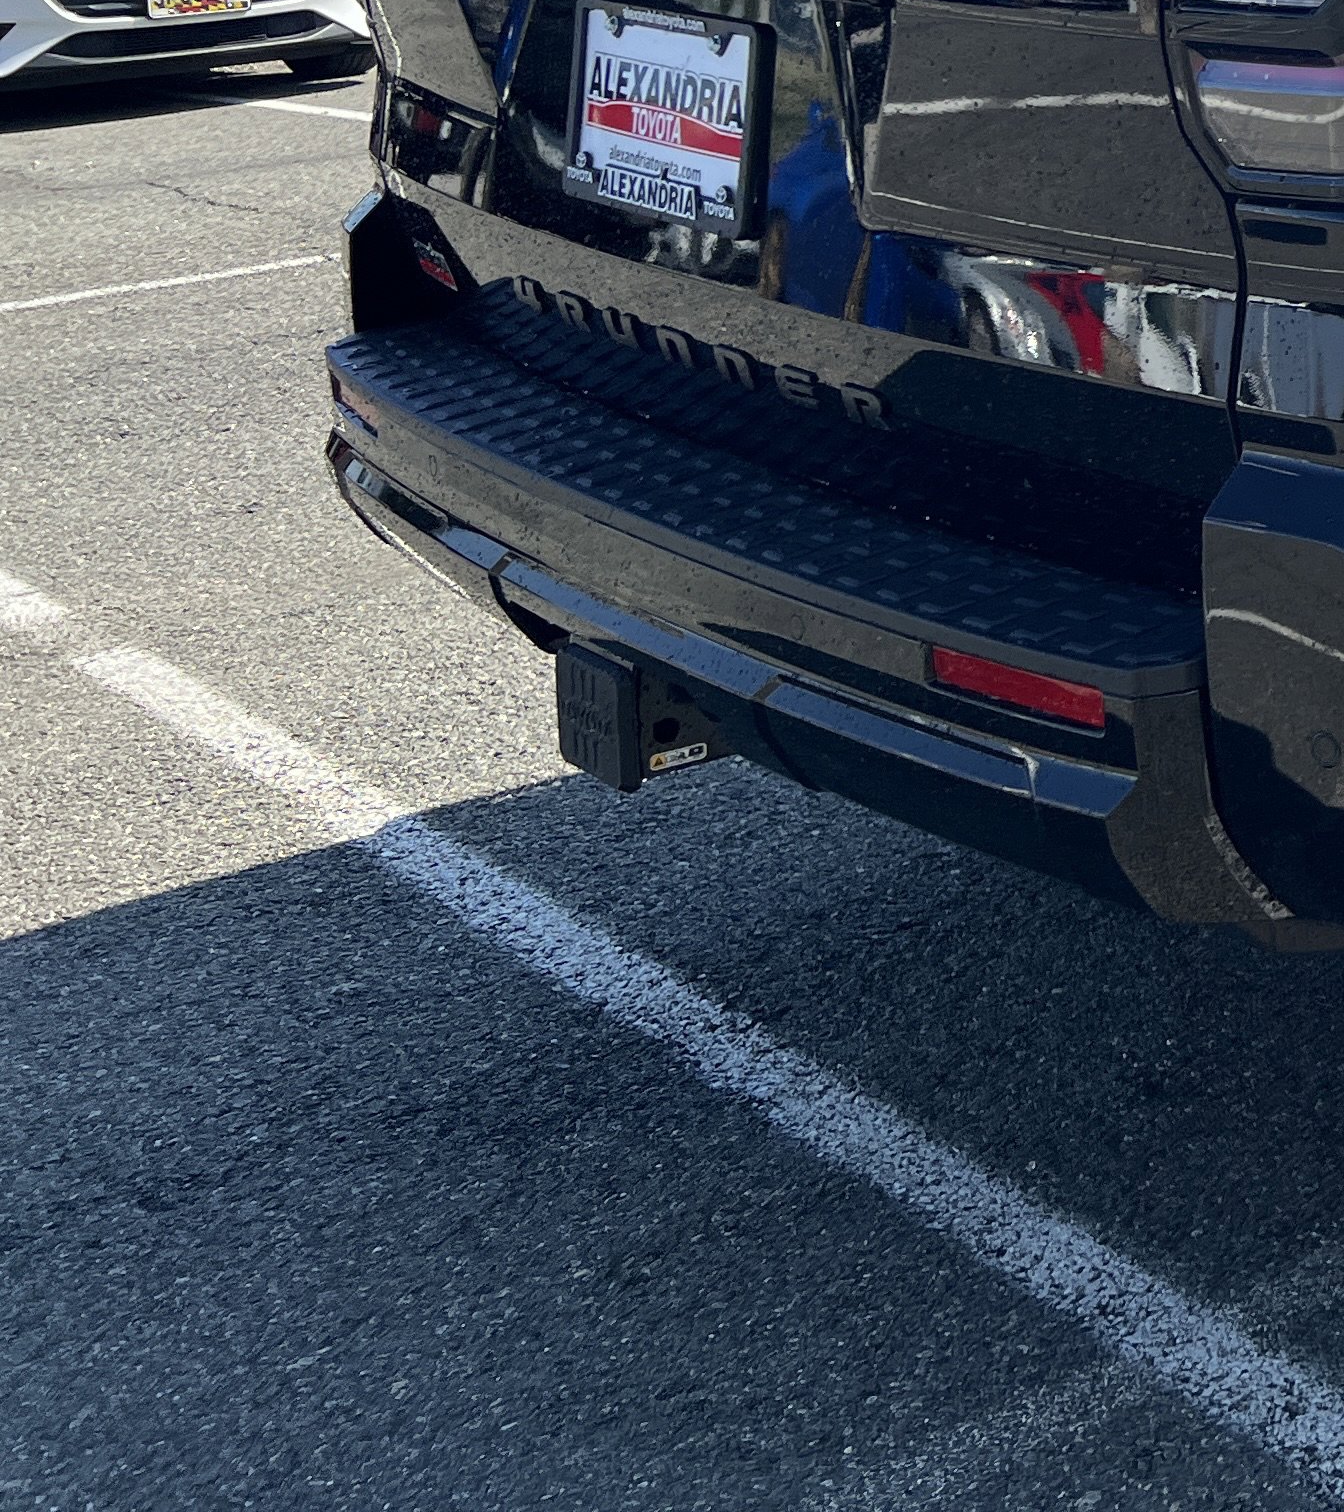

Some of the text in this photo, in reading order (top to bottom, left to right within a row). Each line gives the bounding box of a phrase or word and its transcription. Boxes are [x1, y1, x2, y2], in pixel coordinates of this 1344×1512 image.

[589, 55, 744, 128] ALEXANDRIA
[631, 107, 682, 145] TOYOTA
[566, 165, 594, 184] TOYOTA
[598, 168, 696, 220] ALEXANDRIA
[703, 201, 735, 221] TOYOTA
